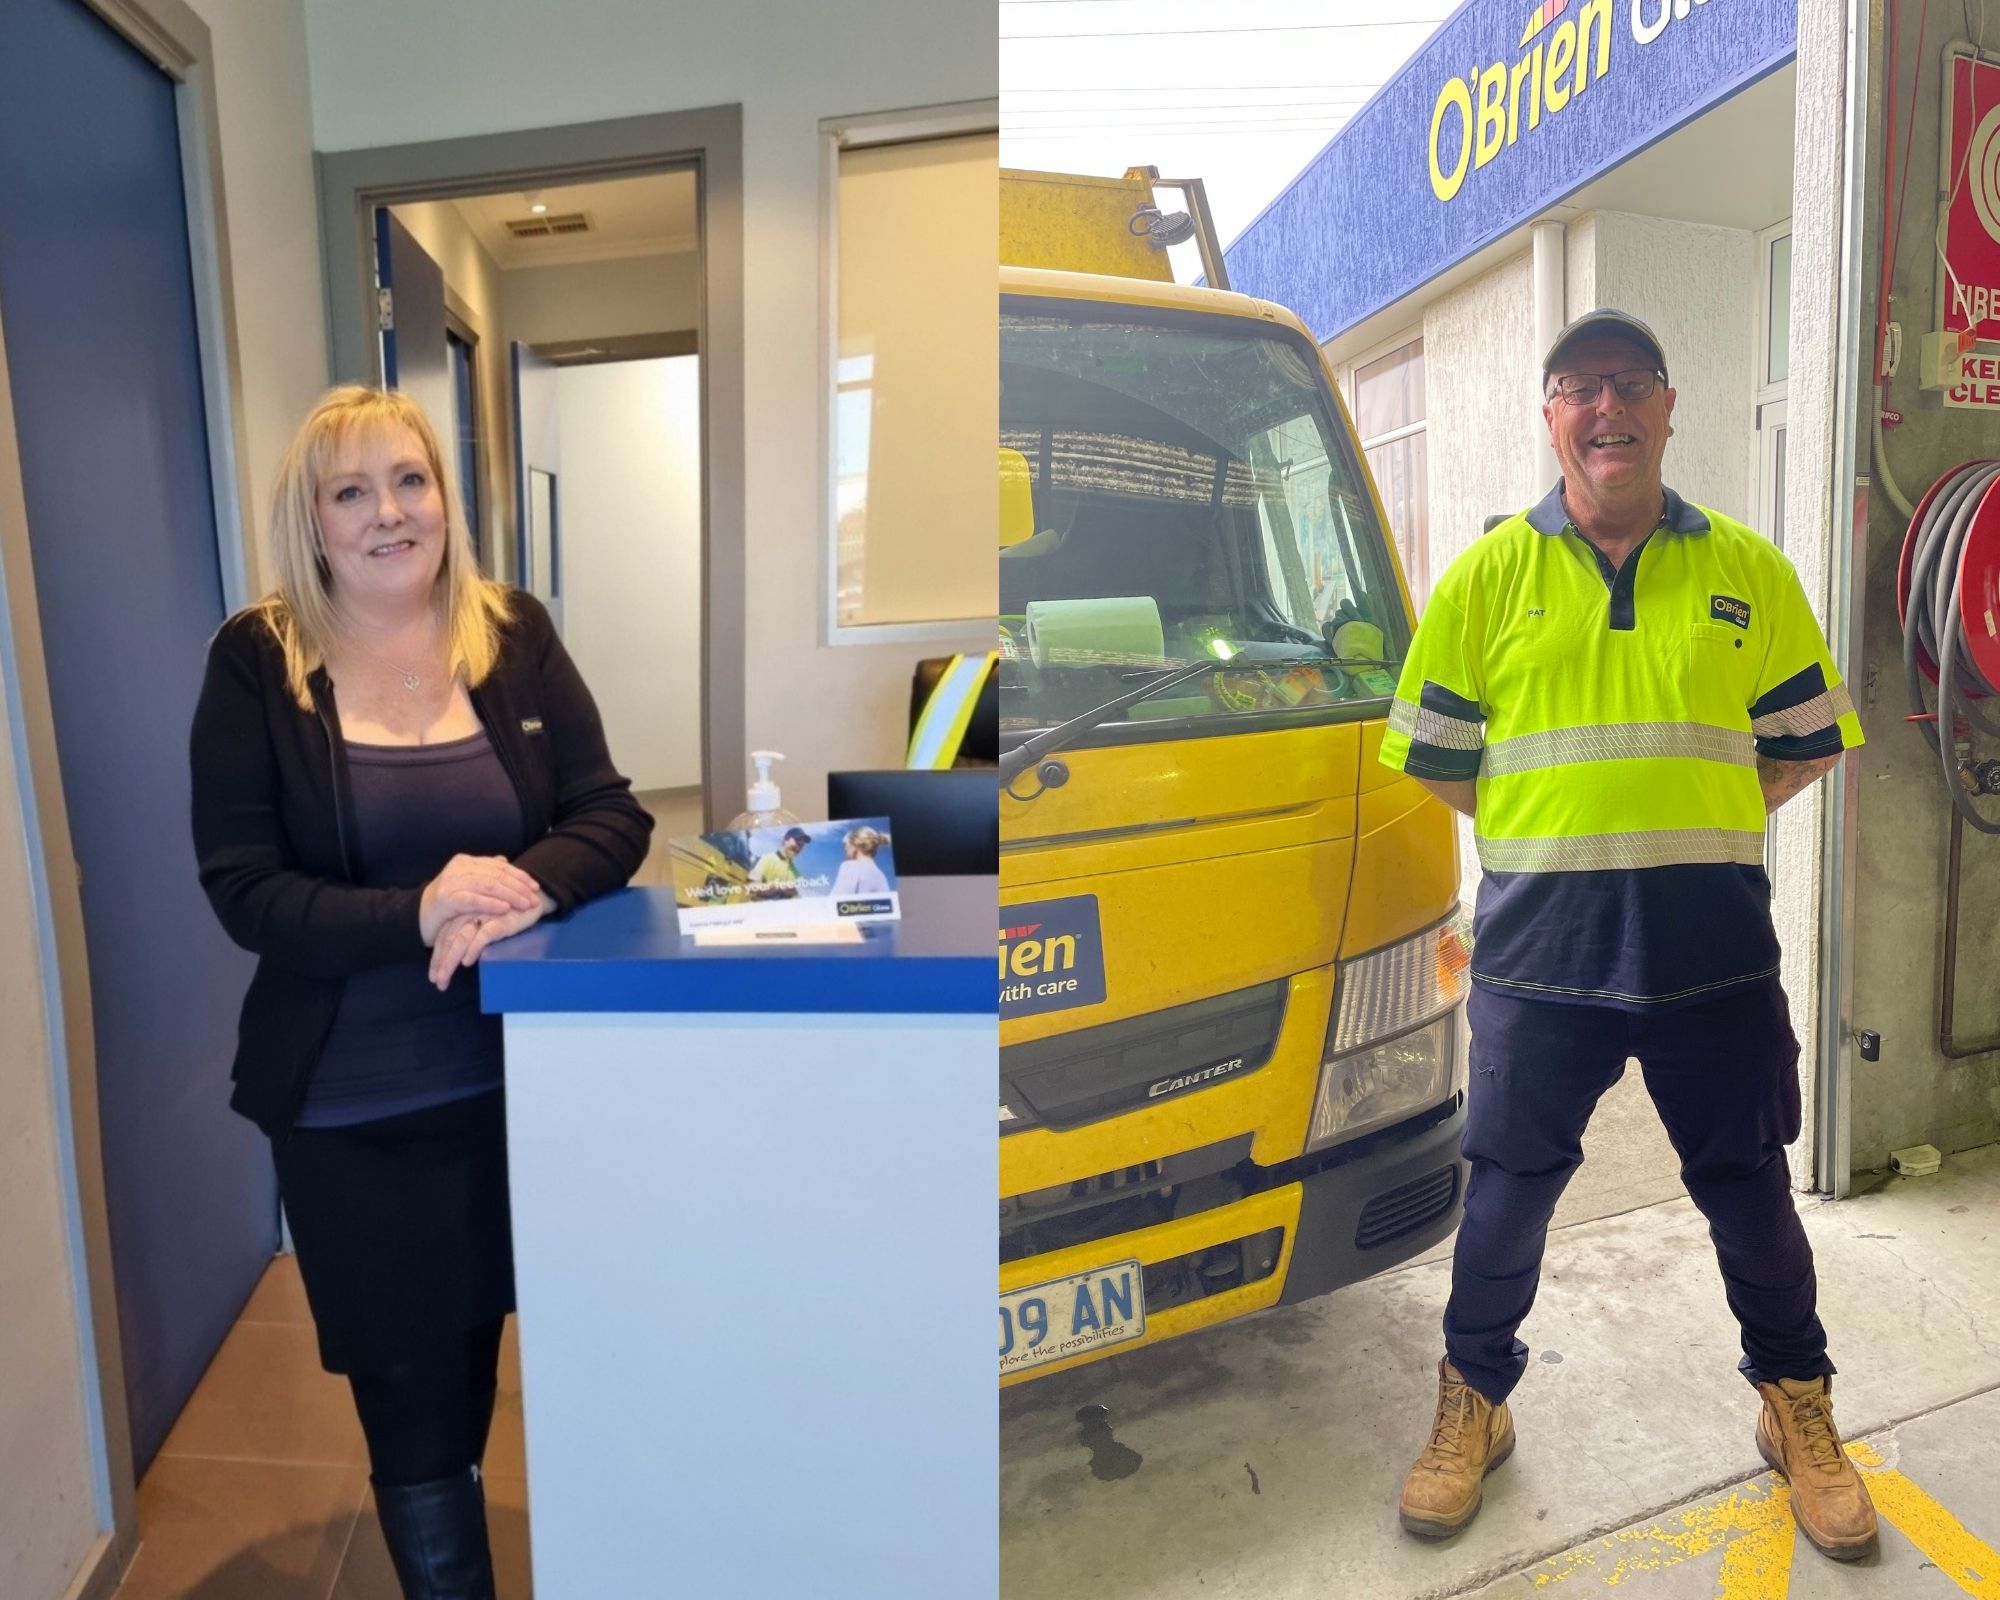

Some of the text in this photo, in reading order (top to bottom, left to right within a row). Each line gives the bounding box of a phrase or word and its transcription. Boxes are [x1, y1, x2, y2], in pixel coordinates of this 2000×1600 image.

[1428, 0, 1613, 201] O'Brien
[1528, 609, 1545, 617] PAT
[1714, 598, 1748, 618] O'Brien
[716, 884, 743, 896] love
[745, 880, 774, 895] your
[775, 874, 830, 890] feedback
[1037, 979, 1078, 996] care
[1148, 1059, 1242, 1098] CANTER
[1072, 1273, 1133, 1336] AN
[1033, 1344, 1057, 1359] the
